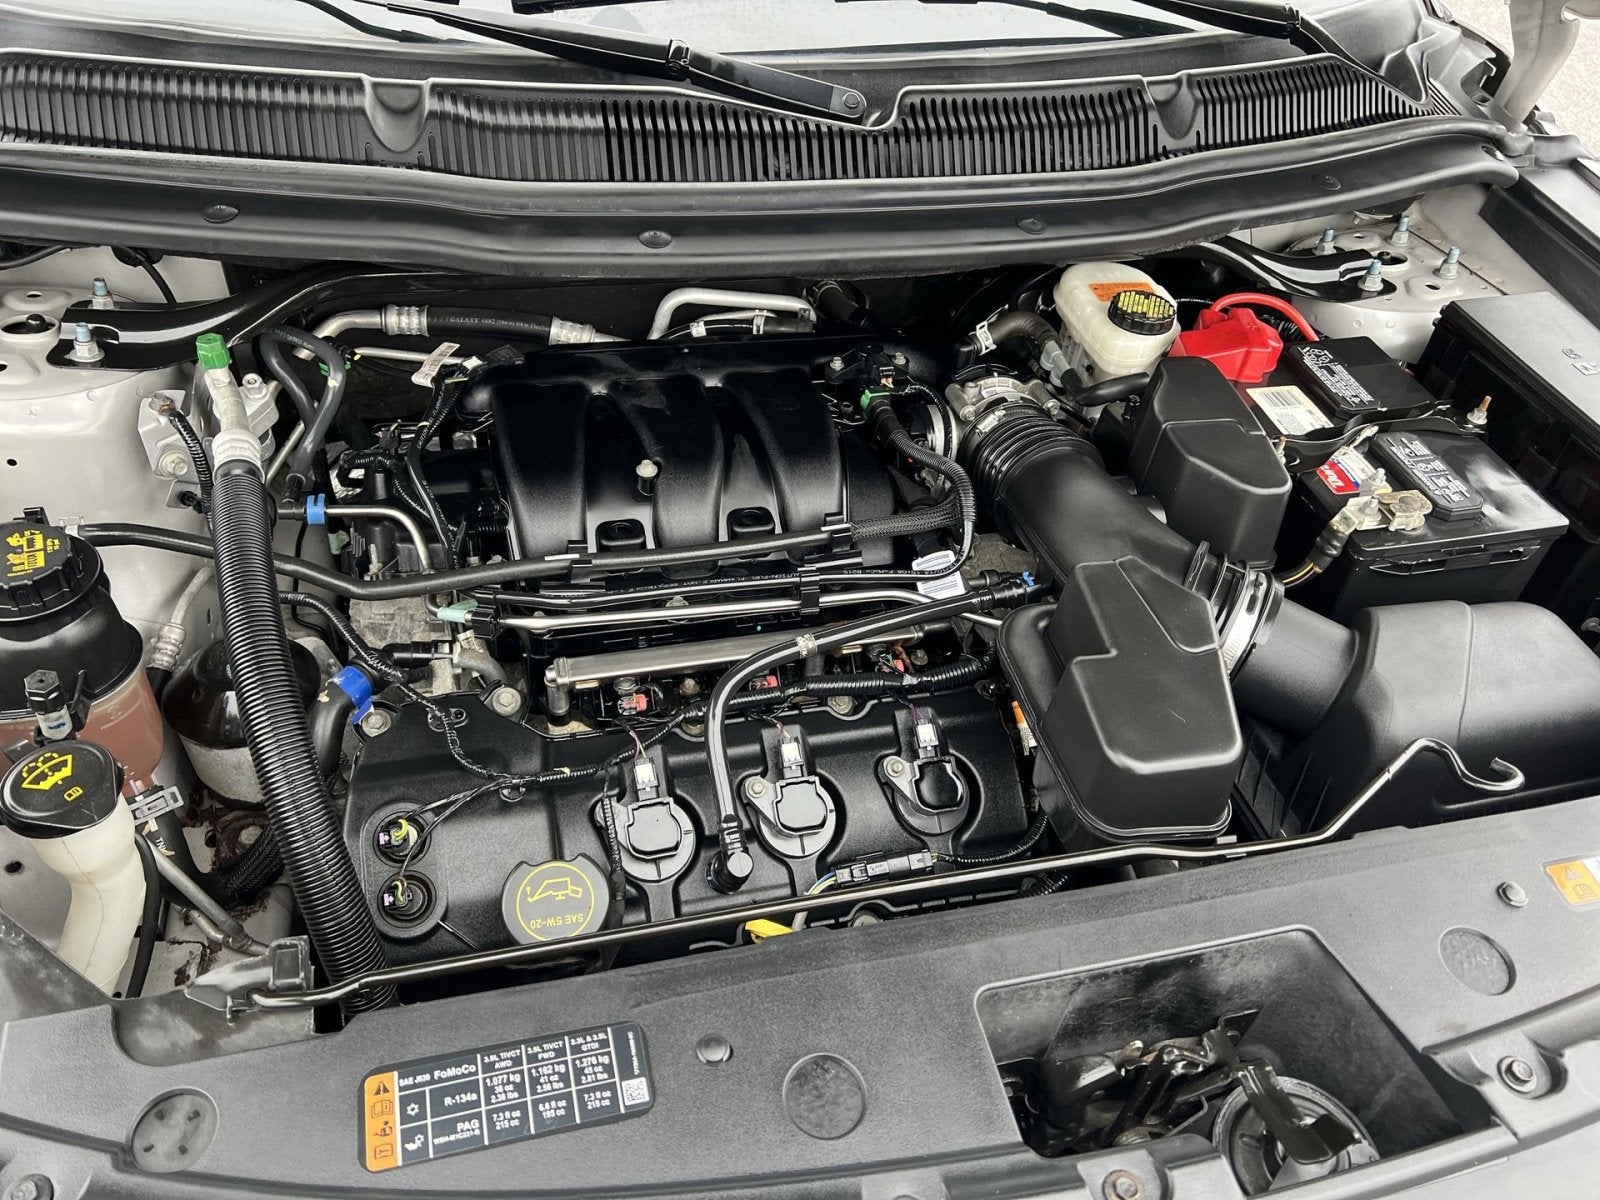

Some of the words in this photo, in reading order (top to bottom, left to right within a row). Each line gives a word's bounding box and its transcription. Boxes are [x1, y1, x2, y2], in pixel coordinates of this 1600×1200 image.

[449, 316, 480, 324] GALAXY
[530, 916, 563, 929] 5W-20
[565, 913, 584, 924] SAE
[527, 1045, 542, 1054] 3.5L
[483, 1054, 499, 1063] 3.5L
[538, 1051, 555, 1060] FWD
[494, 1060, 512, 1069] AWD
[575, 1056, 597, 1068] 1.276
[597, 1054, 610, 1064] kg
[531, 1065, 553, 1077] 1.162
[554, 1064, 566, 1073] kg
[584, 1066, 593, 1074] 45
[399, 1077, 414, 1087] SAE
[434, 1064, 476, 1080] FoMoCo
[485, 1074, 508, 1087] 1.077
[509, 1073, 521, 1083] kg
[539, 1075, 548, 1083] 41
[596, 1072, 609, 1081] lbs
[552, 1081, 564, 1089] lbs
[444, 1091, 478, 1107] R-134a
[507, 1091, 519, 1100] lbs
[583, 1092, 595, 1101] 7.3
[587, 1100, 601, 1110] 215
[492, 1112, 504, 1122] 7.3
[542, 1109, 555, 1119] 195
[456, 1119, 480, 1132] PAG
[495, 1120, 509, 1130] 215
